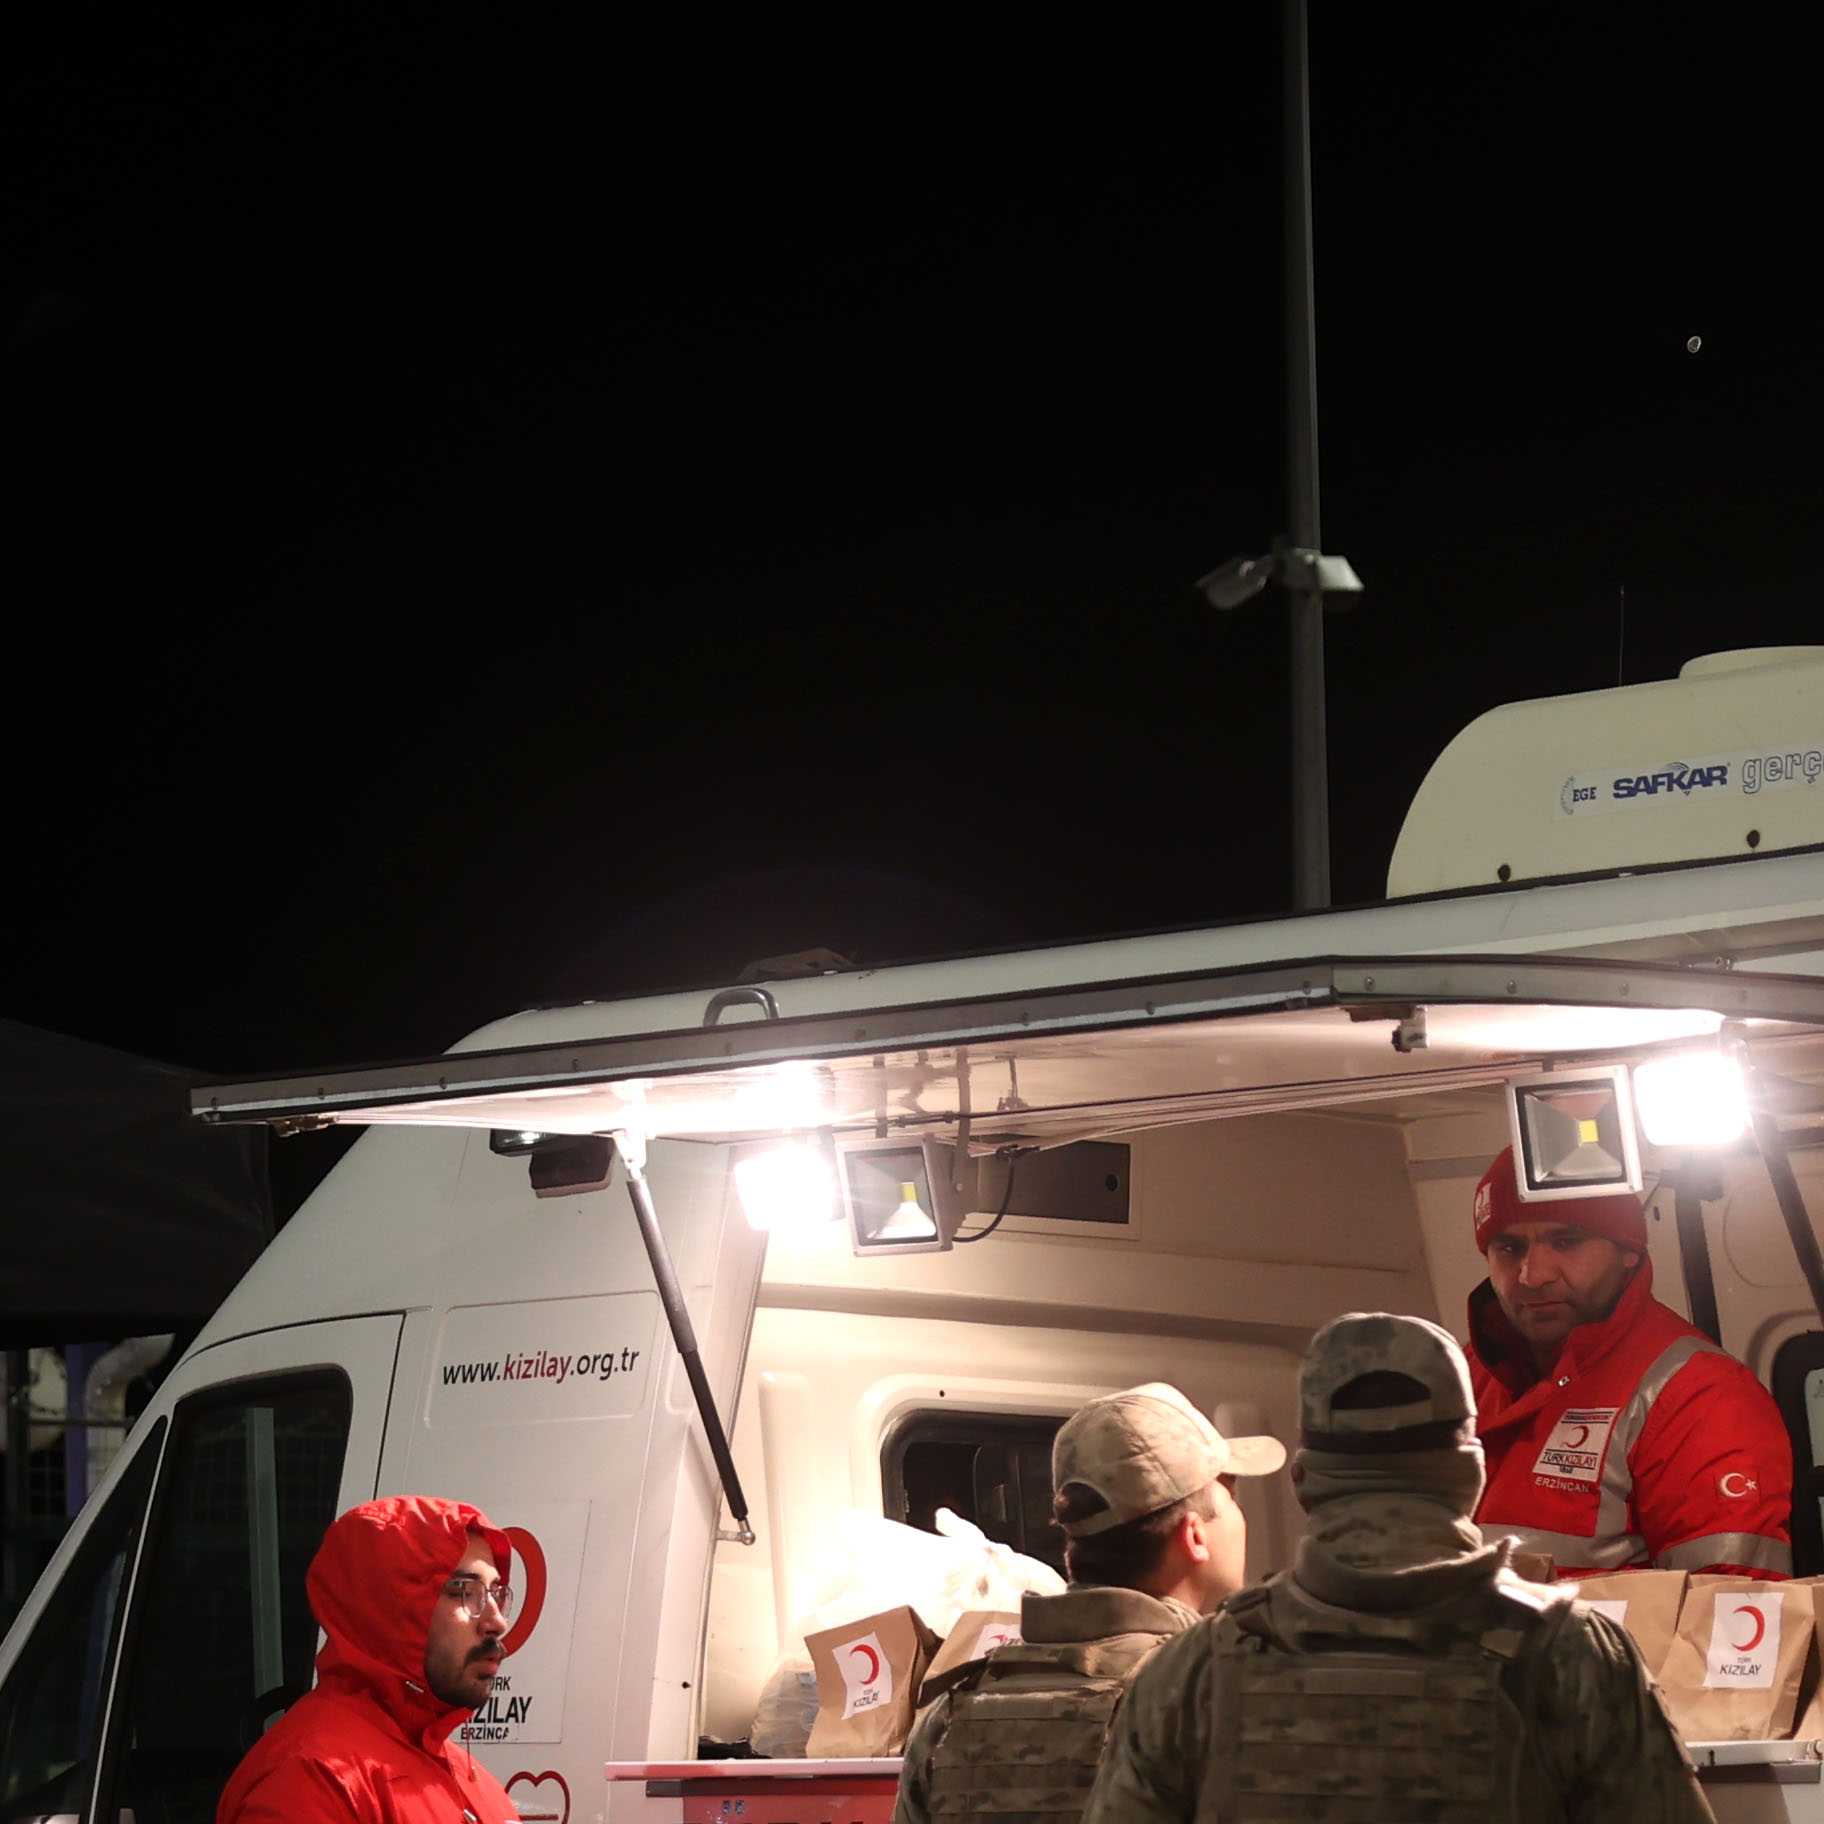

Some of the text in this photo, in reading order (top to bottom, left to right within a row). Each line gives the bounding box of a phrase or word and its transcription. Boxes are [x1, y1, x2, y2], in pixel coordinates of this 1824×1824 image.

[1612, 764, 1729, 799] SAFKAR
[442, 1347, 640, 1386] www.kizilay.org.tr
[468, 1695, 533, 1724] ZILAY
